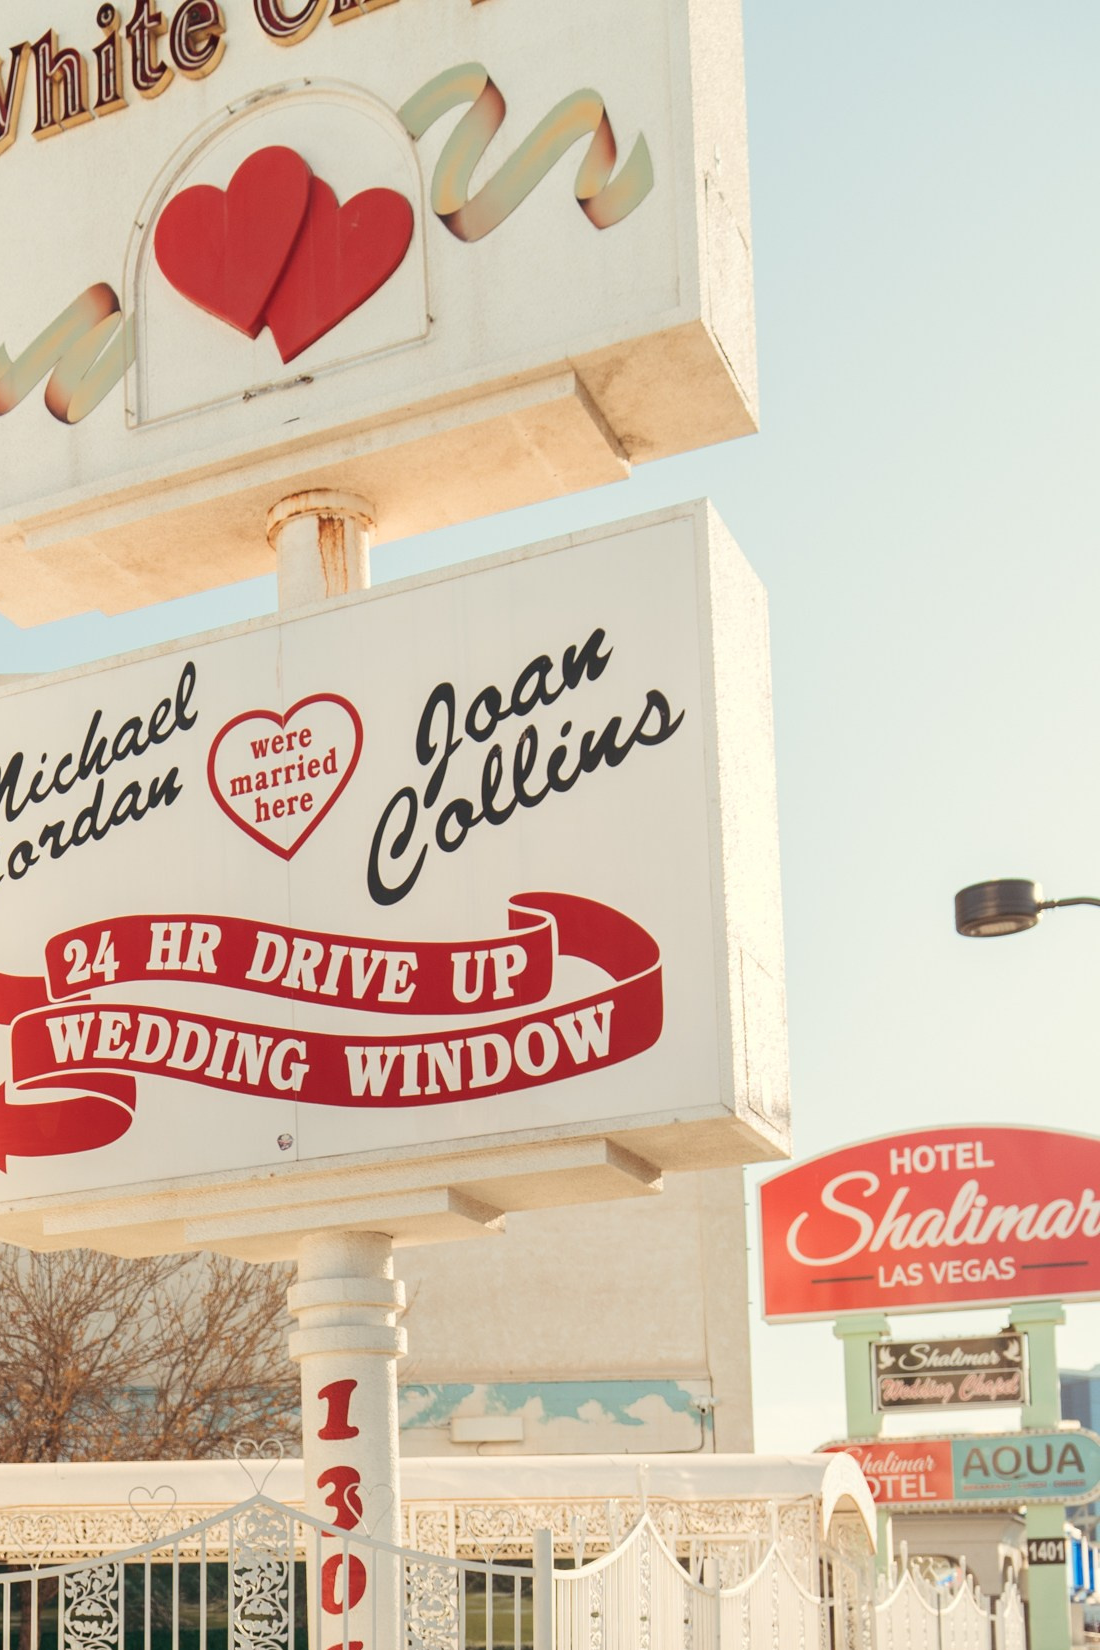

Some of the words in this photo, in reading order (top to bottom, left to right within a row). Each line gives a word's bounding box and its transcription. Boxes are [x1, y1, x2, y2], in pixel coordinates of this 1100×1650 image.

[416, 627, 613, 809] Joan
[250, 727, 312, 759] were
[230, 746, 338, 797] married
[255, 791, 313, 823] here
[367, 689, 685, 906] Collins
[63, 930, 120, 985] 24
[146, 922, 222, 974] HR
[245, 930, 418, 1003] DRIVE
[451, 944, 528, 1003] UP
[45, 1011, 310, 1091] WEDDING
[344, 1000, 615, 1097] WINDOW
[889, 1141, 995, 1175] HOTEL
[786, 1170, 1100, 1266] Shalimar
[878, 1263, 923, 1288] LAS
[929, 1257, 1016, 1284] VEGAS
[898, 1343, 1001, 1371] Shalimar
[881, 1376, 955, 1404] Wedding
[958, 1372, 1021, 1402] Chapel
[963, 1442, 1085, 1480] AQUA
[864, 1473, 938, 1500] OTEL
[1029, 1540, 1065, 1562] 1401
